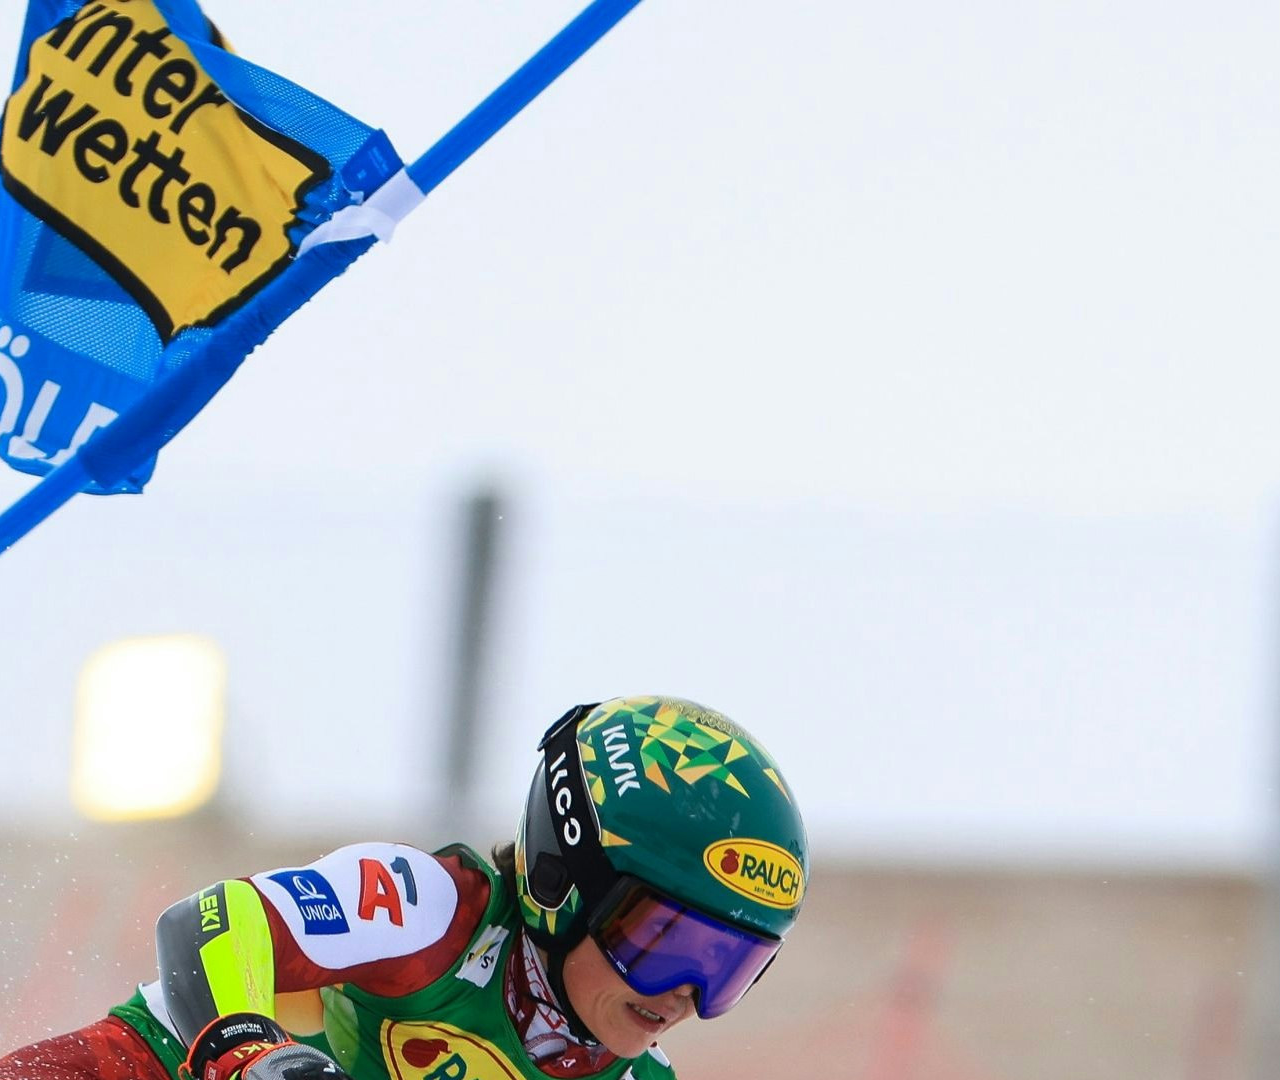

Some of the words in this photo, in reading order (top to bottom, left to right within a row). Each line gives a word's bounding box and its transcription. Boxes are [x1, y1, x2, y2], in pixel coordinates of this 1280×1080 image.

[17, 74, 263, 275] wetten
[602, 724, 641, 798] KASK
[358, 857, 418, 928] A1
[740, 853, 800, 899] RAUCH
[300, 904, 342, 922] UNIQA
